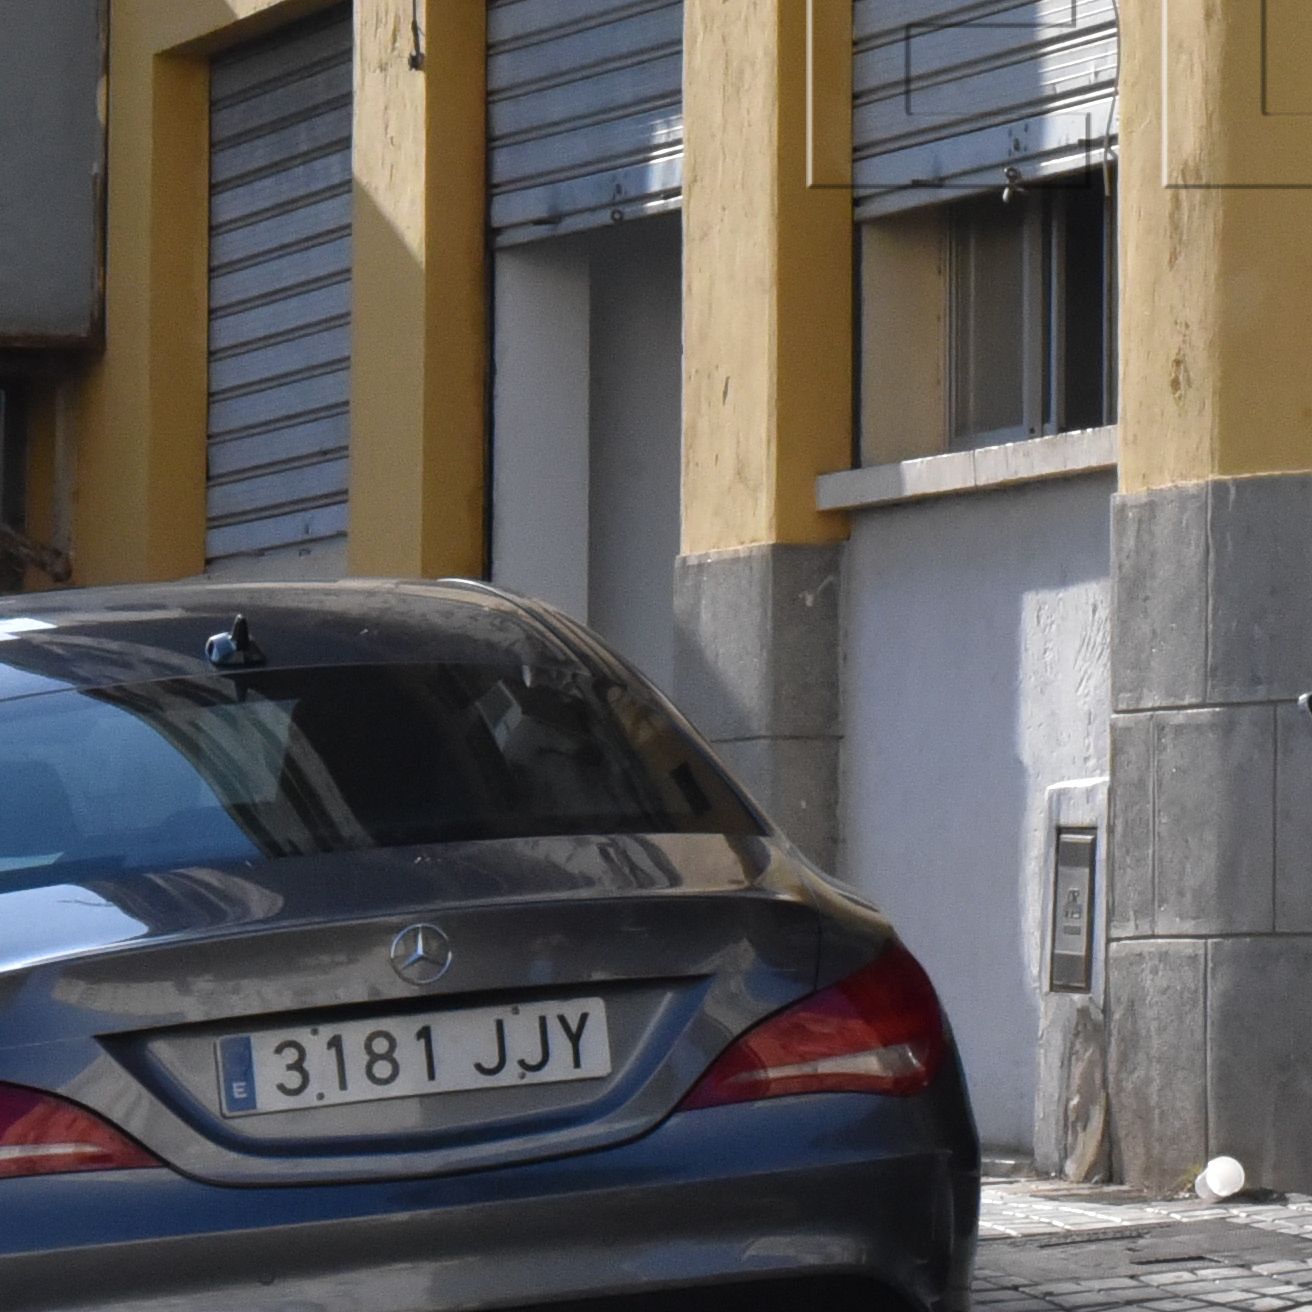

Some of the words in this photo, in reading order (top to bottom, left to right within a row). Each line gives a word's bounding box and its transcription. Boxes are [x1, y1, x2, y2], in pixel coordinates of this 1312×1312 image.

[233, 1082, 247, 1099] E
[273, 1025, 437, 1097] 3181
[473, 1011, 590, 1077] JJY
